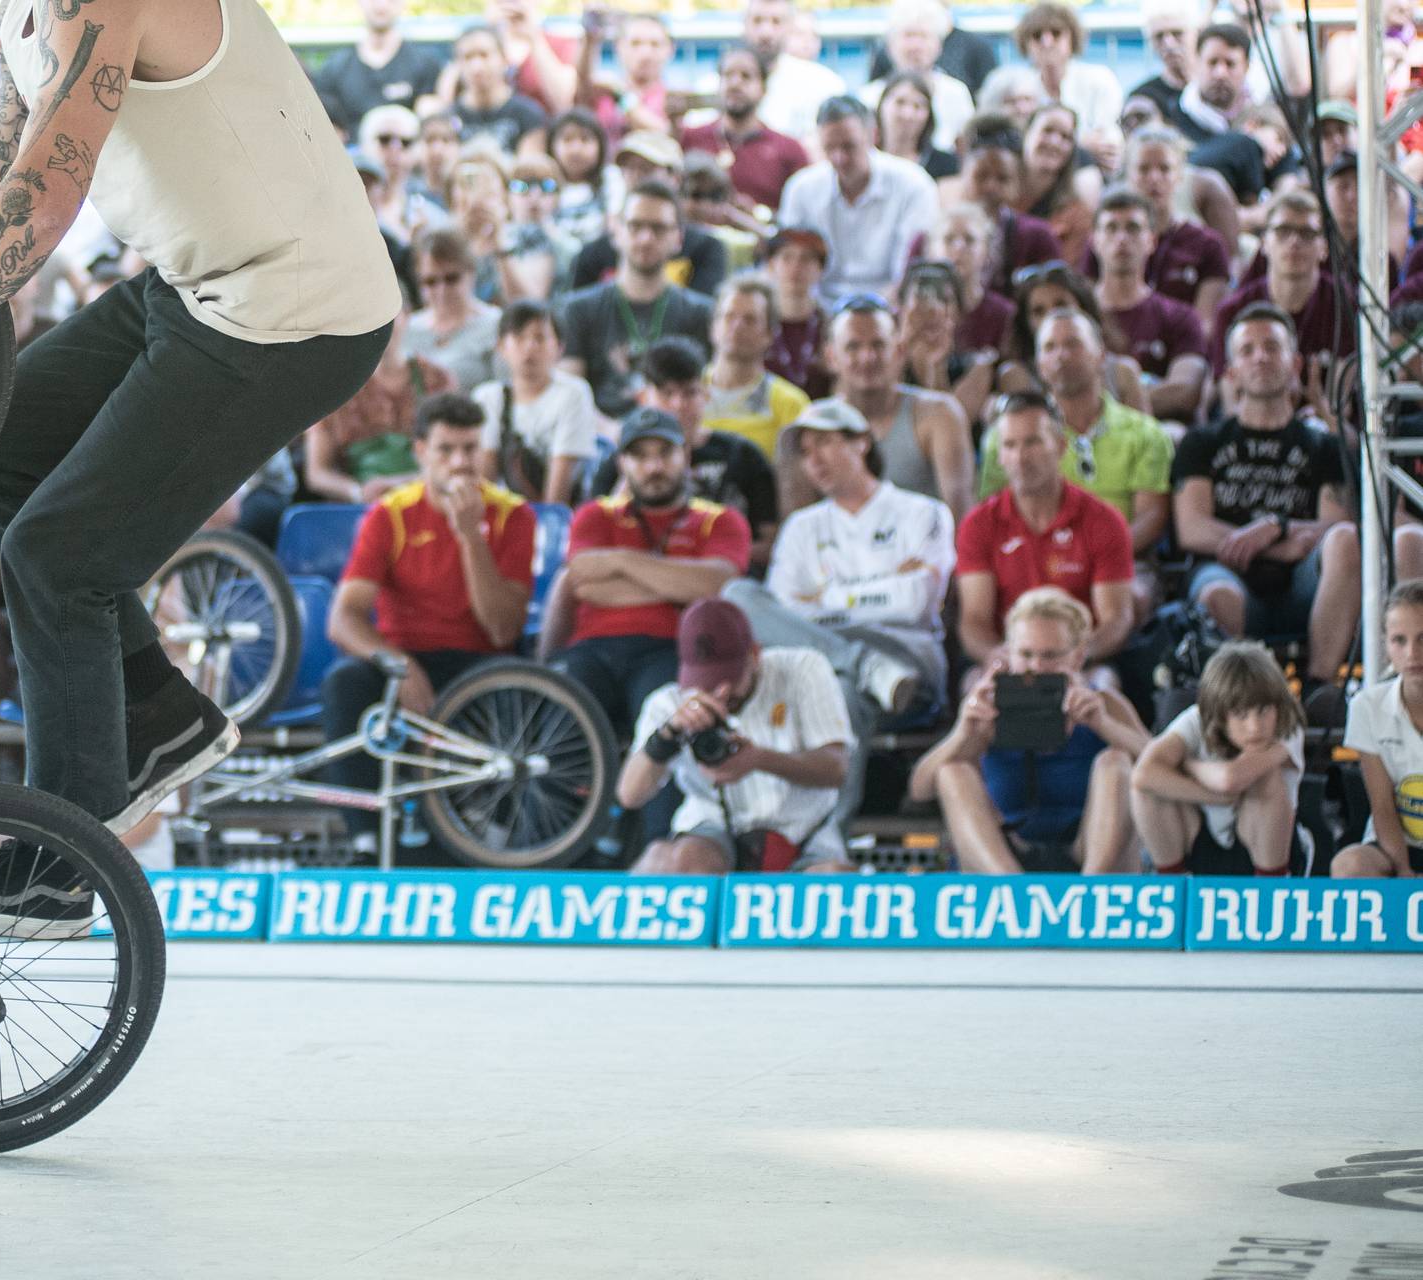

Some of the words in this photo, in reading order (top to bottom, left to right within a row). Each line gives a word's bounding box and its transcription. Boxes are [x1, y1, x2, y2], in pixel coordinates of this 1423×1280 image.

[278, 879, 457, 937] RUHR
[469, 883, 709, 941] GAMES
[729, 883, 918, 940] RUHR
[934, 884, 1176, 940] GAMES
[1195, 887, 1388, 943] RUHR
[112, 1005, 137, 1054] ODYSSEY
